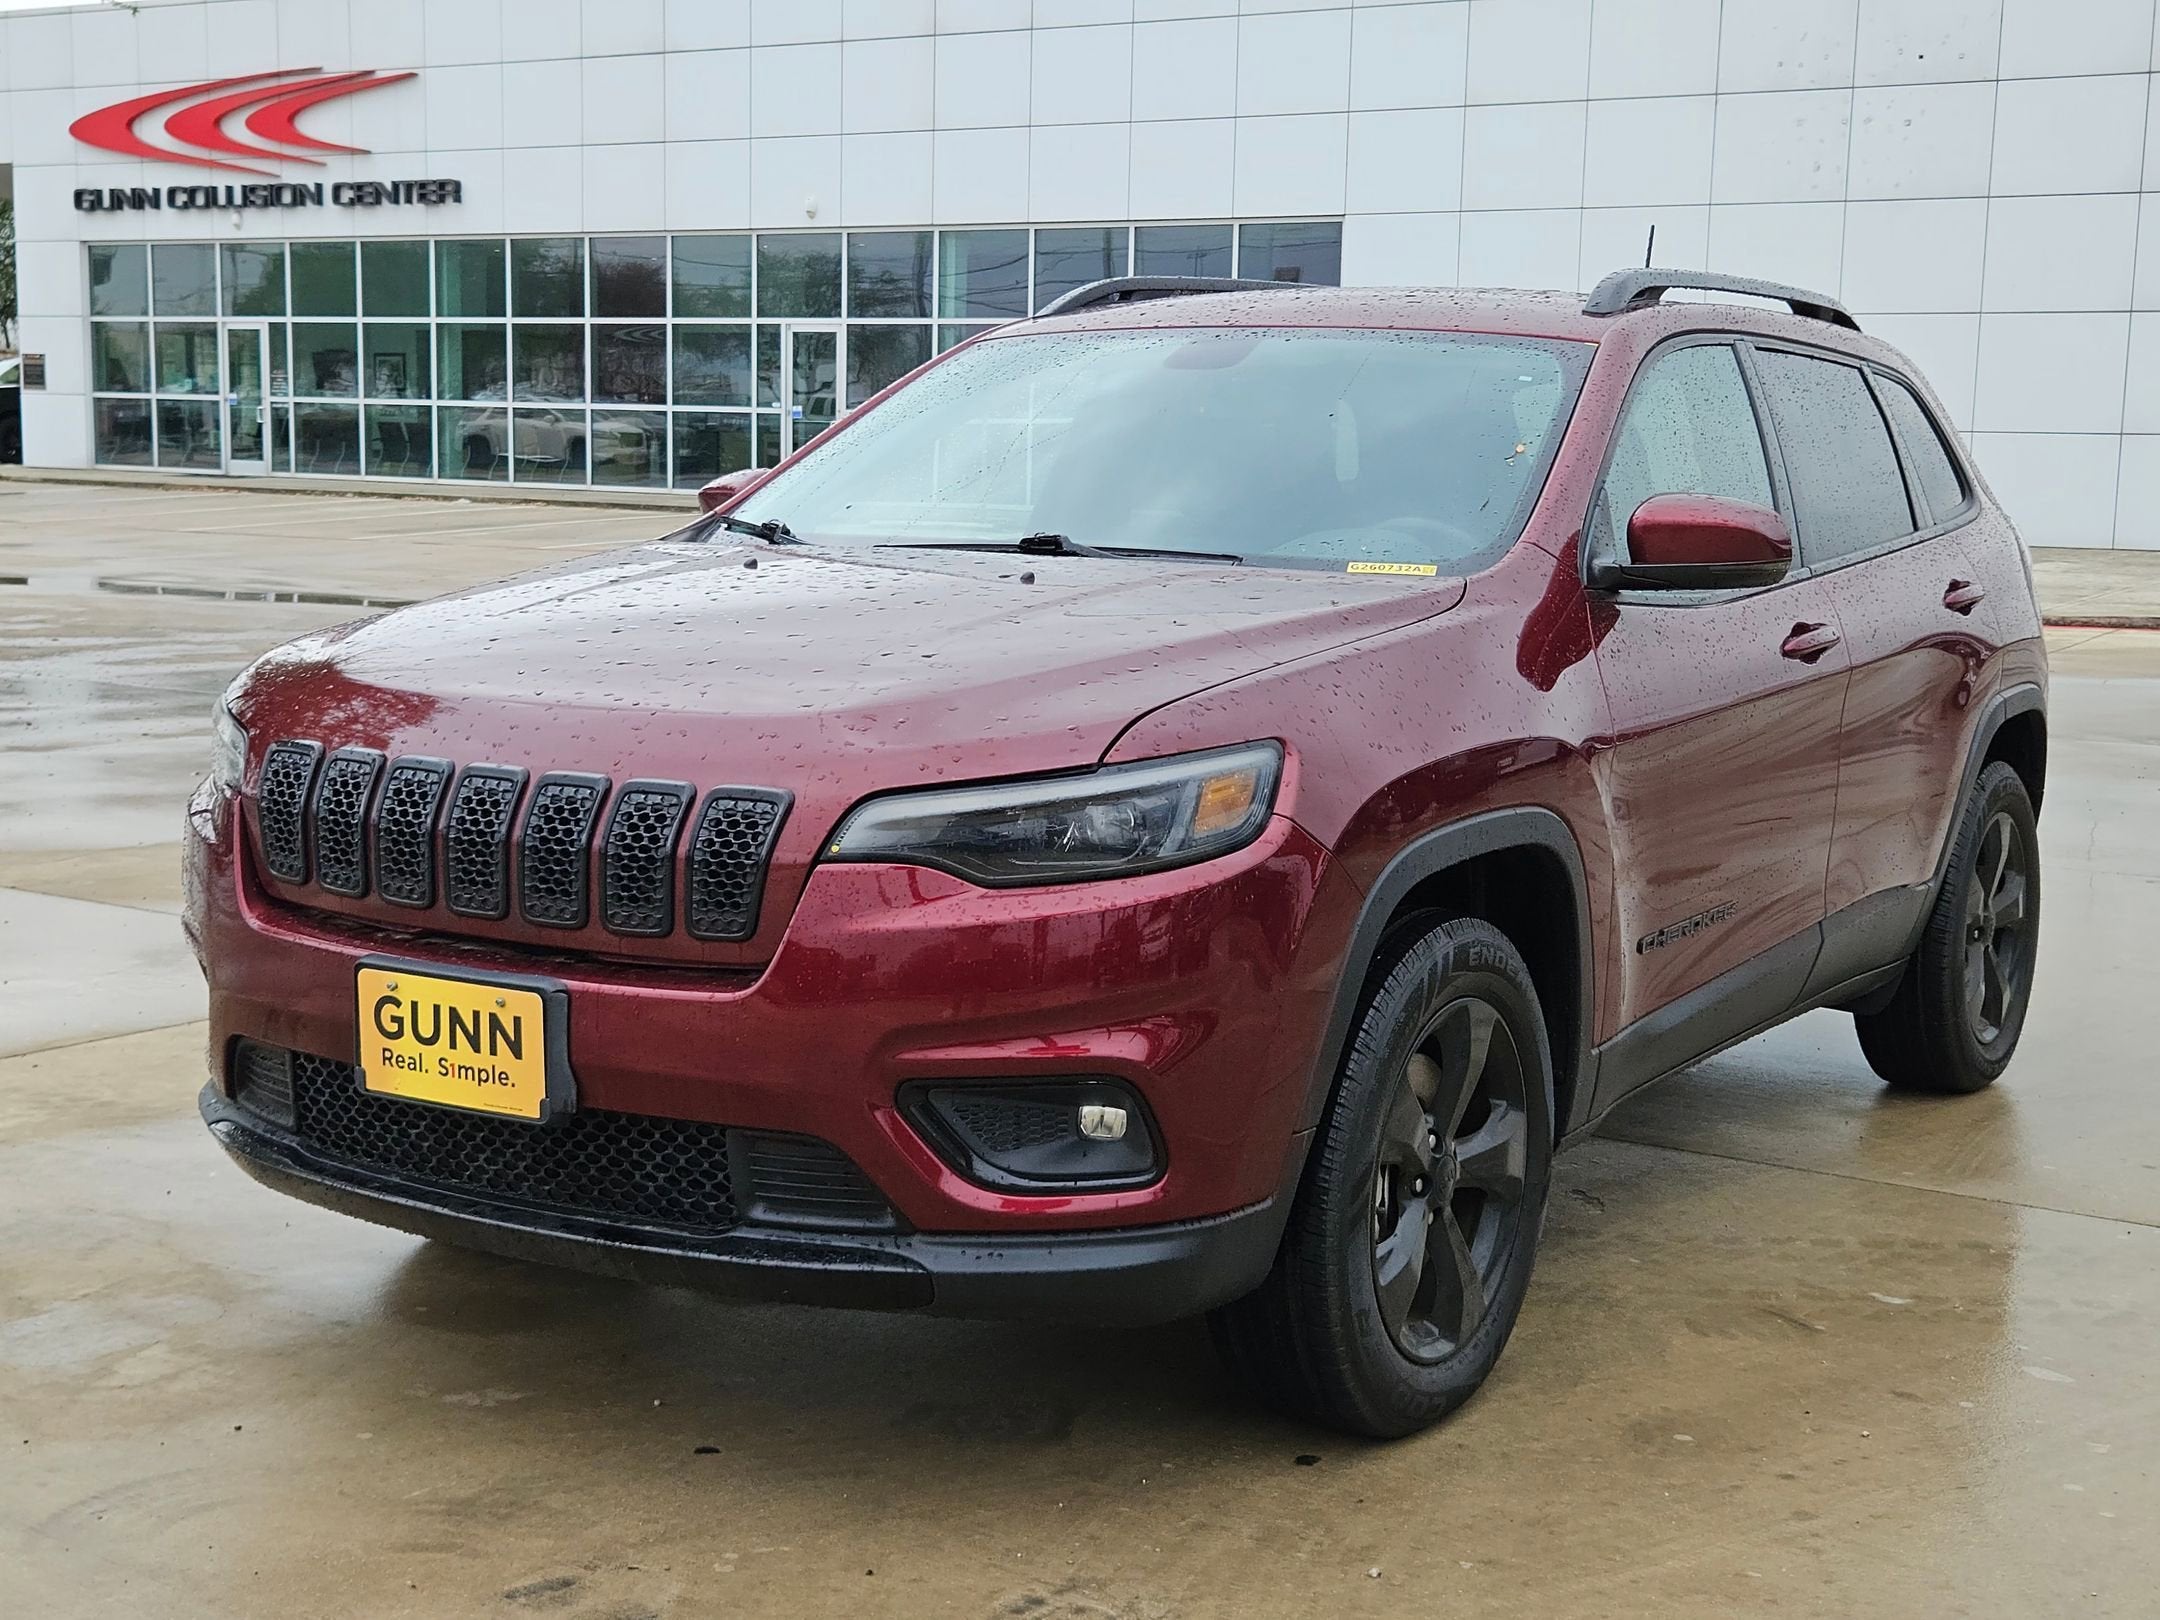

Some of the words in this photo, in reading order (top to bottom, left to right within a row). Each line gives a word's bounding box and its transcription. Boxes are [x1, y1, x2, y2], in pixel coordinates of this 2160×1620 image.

[74, 187, 161, 212] GUNN
[167, 182, 323, 210] COLLISION
[332, 178, 462, 207] CENTER
[1636, 899, 1739, 955] CHEROKEE
[373, 995, 524, 1061] GUNN
[381, 1047, 429, 1074] Real.
